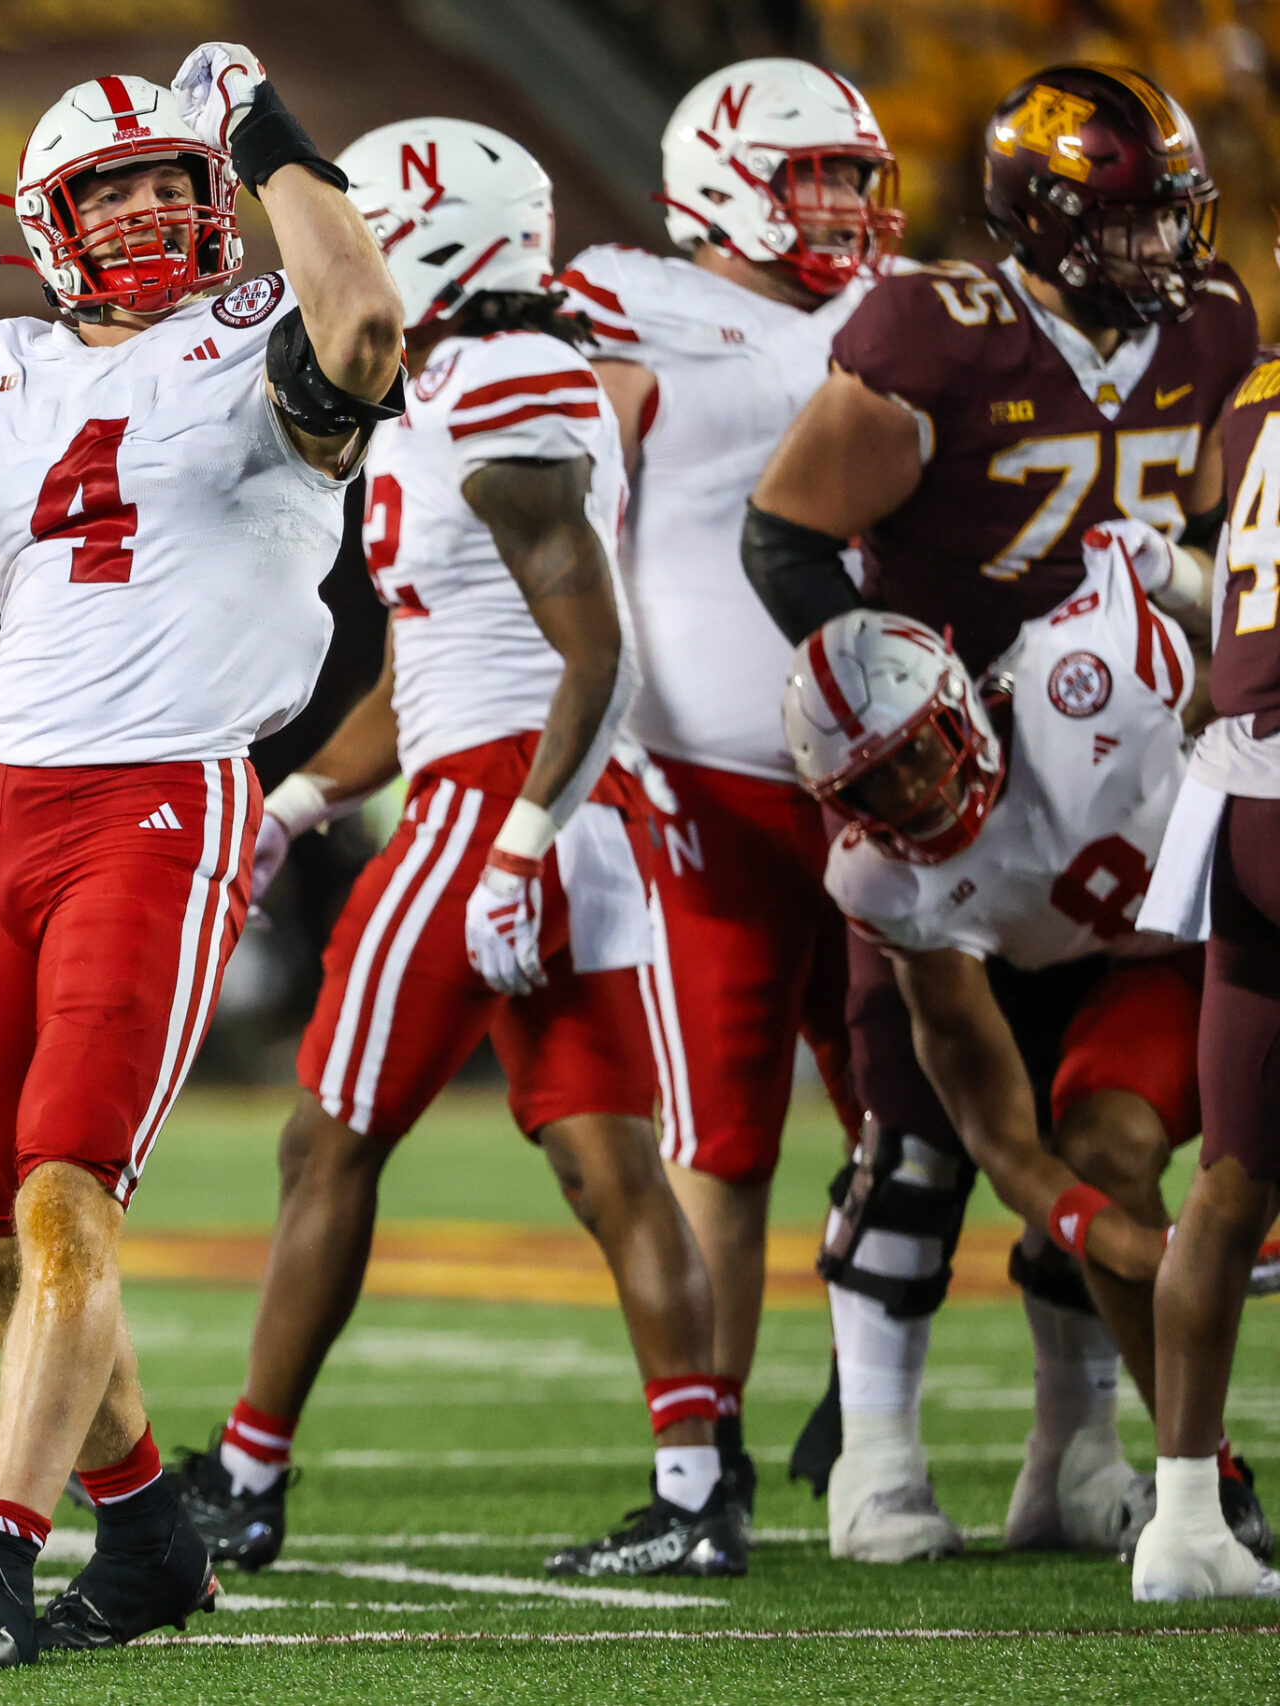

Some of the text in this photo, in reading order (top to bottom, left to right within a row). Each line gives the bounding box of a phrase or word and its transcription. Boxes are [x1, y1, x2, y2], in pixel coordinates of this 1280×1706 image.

[712, 83, 753, 130] N
[112, 126, 151, 142] HUSKERS
[992, 84, 1097, 183] M
[402, 142, 437, 190] N
[227, 290, 267, 303] HUSKERS
[245, 296, 277, 324] TRADITION
[31, 416, 138, 583] 4
[980, 422, 1202, 581] 75
[664, 819, 705, 877] N
[1050, 834, 1152, 940] 8
